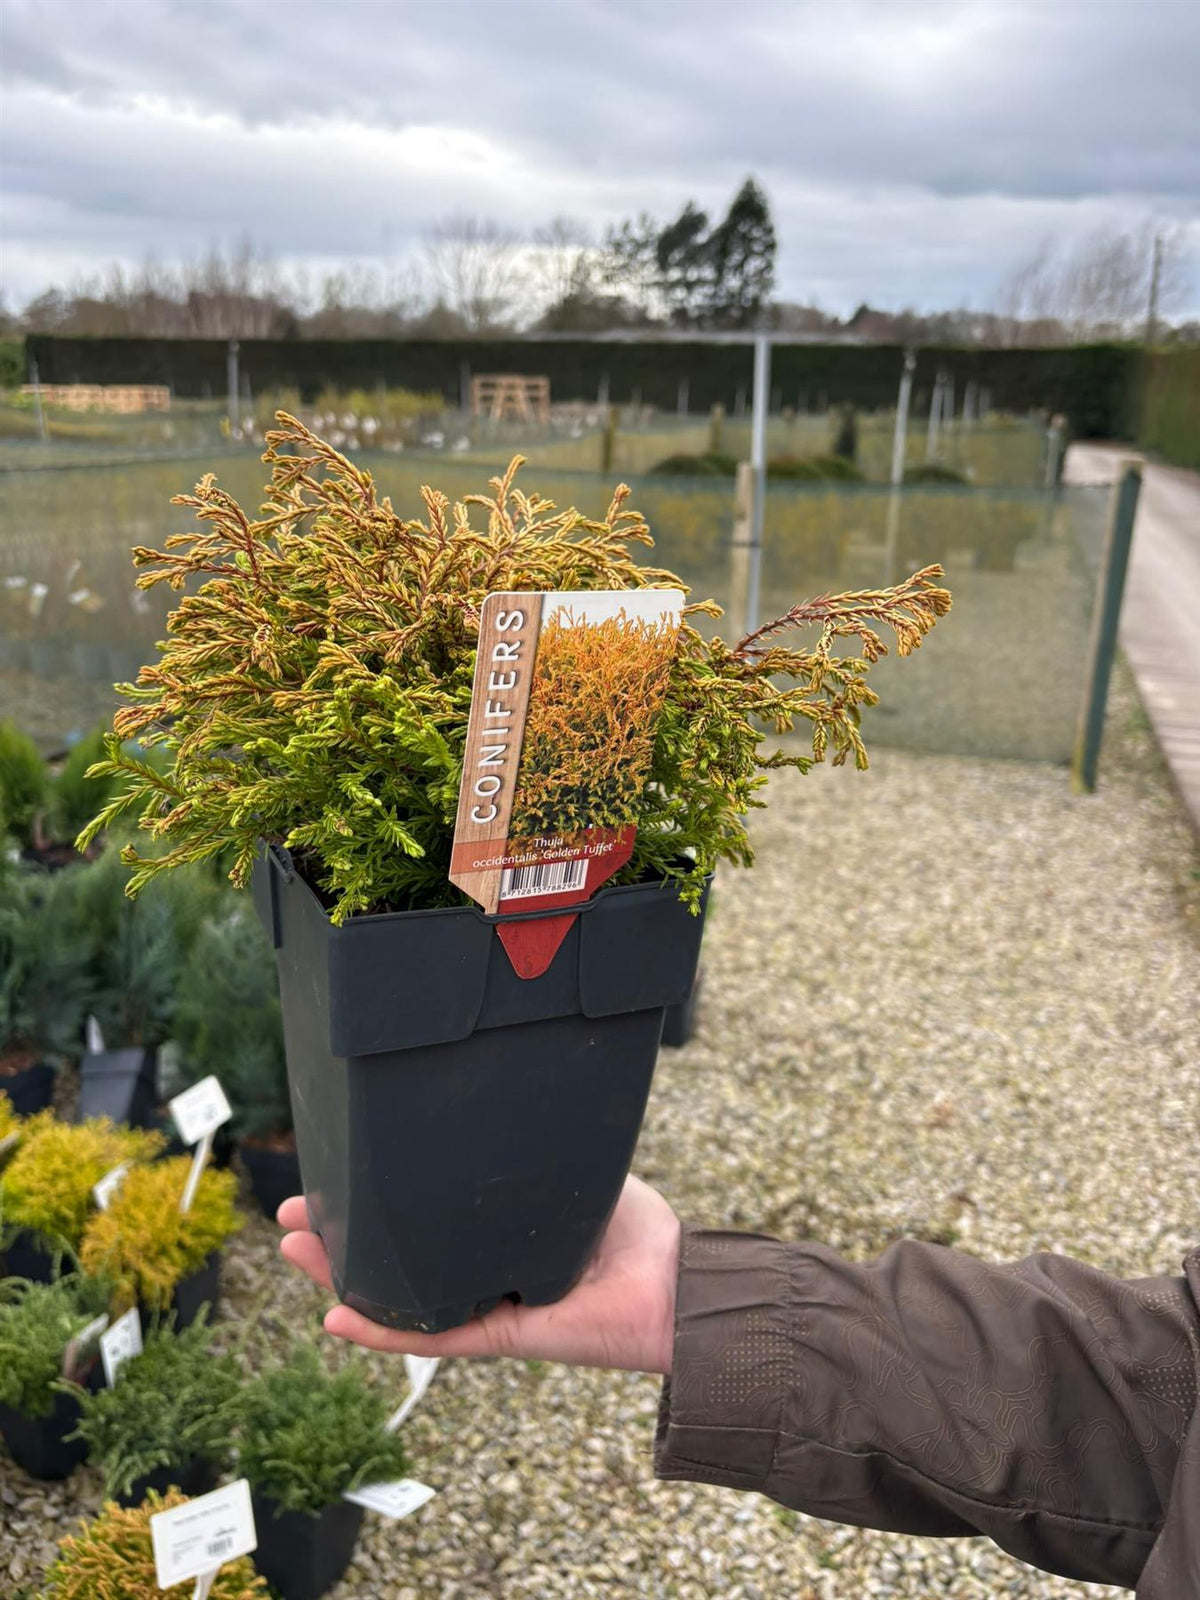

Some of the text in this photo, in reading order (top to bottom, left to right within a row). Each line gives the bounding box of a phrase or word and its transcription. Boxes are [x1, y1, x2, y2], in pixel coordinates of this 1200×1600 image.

[471, 609, 525, 824] CONIFERS
[535, 837, 563, 848] Thuja
[472, 852, 537, 867] occidentalis
